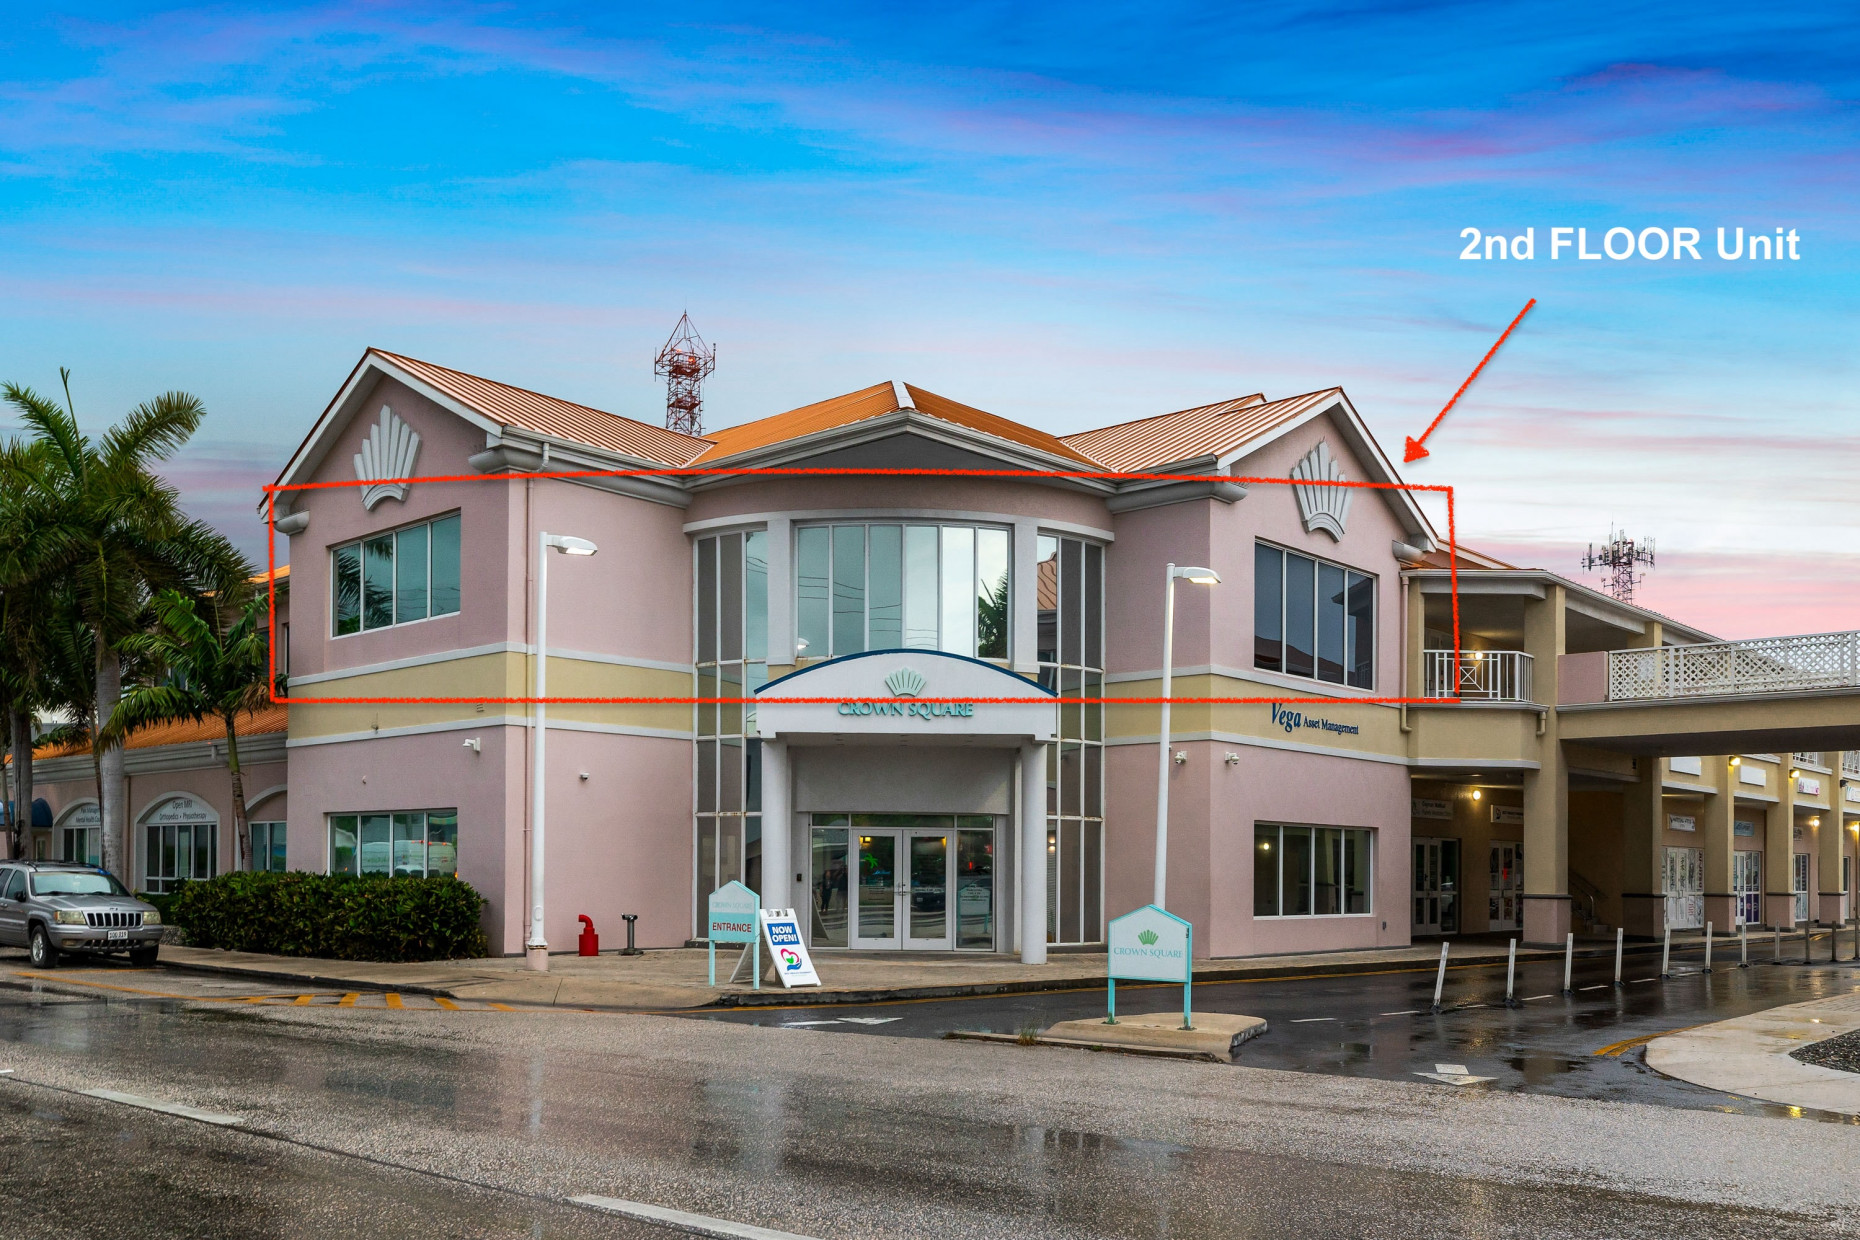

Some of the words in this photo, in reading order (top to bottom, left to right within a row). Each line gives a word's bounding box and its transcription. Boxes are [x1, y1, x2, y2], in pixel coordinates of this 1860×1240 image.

[838, 702, 903, 716] CROWN
[908, 703, 974, 720] SQUARE
[1271, 702, 1302, 733] Vega
[1303, 716, 1320, 729] Asset
[1321, 719, 1359, 735] Management
[172, 800, 183, 810] Open
[712, 922, 752, 933] ENTRANCE
[772, 926, 793, 934] NOW
[772, 934, 798, 943] OPEN!
[1113, 947, 1148, 956] CROWN
[1149, 948, 1183, 959] SQUARE
